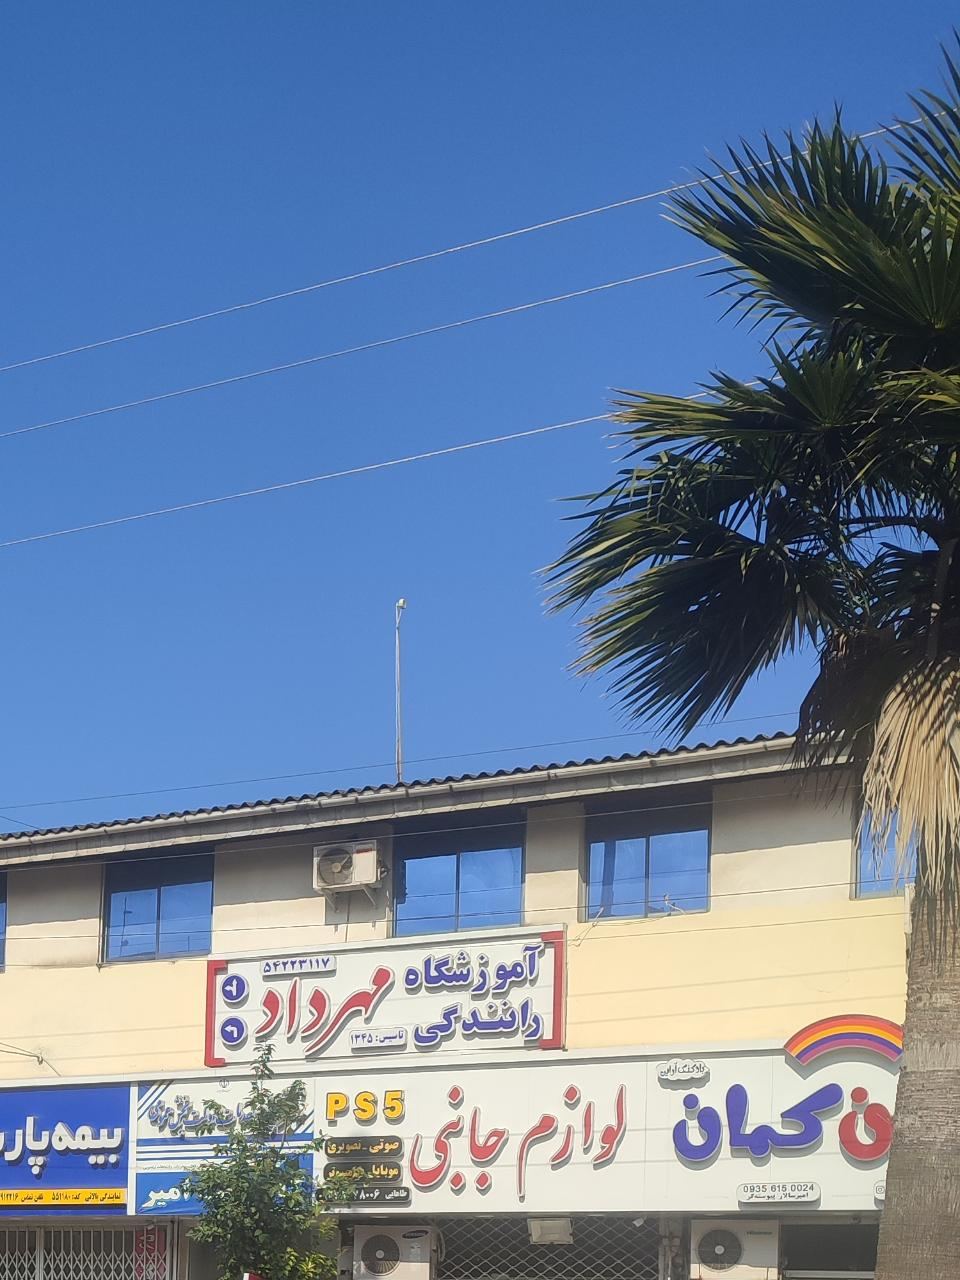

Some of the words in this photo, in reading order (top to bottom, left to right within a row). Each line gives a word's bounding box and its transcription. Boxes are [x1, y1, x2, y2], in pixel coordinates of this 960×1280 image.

[263, 956, 331, 974] ۵۴۲۲۳۱۱۷
[404, 943, 544, 994] آموزشگاه
[254, 966, 392, 1053] مهرداد
[414, 997, 541, 1044] رانندگی
[325, 1089, 404, 1121] PS5
[672, 1082, 844, 1162] کمان
[51, 1121, 123, 1164] بیمه
[327, 1139, 362, 1154] تصویری
[369, 1138, 400, 1154] صوتی
[408, 1085, 508, 1190] جانبی
[517, 1083, 627, 1197] لوازم
[743, 1184, 768, 1193] 0935
[770, 1184, 787, 1192] 615
[790, 1183, 815, 1192] 0024
